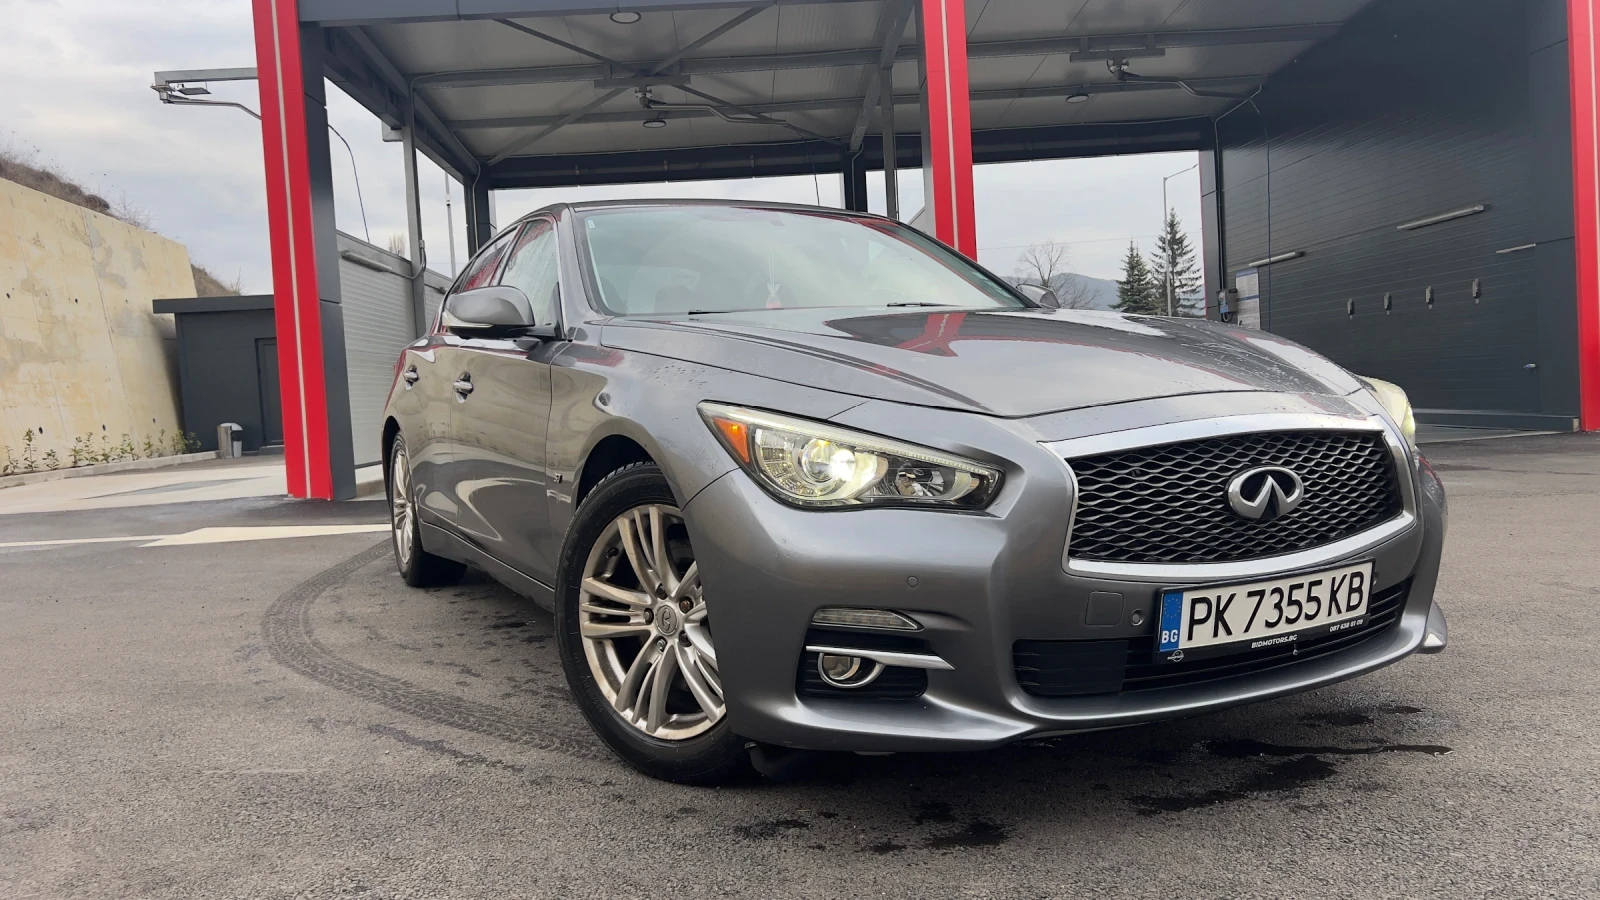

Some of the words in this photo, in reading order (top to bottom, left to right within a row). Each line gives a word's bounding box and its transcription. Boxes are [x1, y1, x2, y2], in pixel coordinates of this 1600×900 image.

[1187, 592, 1237, 641] PK
[1243, 579, 1323, 634] 7355
[1327, 570, 1365, 617] KB
[1161, 629, 1179, 644] BG
[1251, 634, 1298, 649] BIDMOTORS.BG
